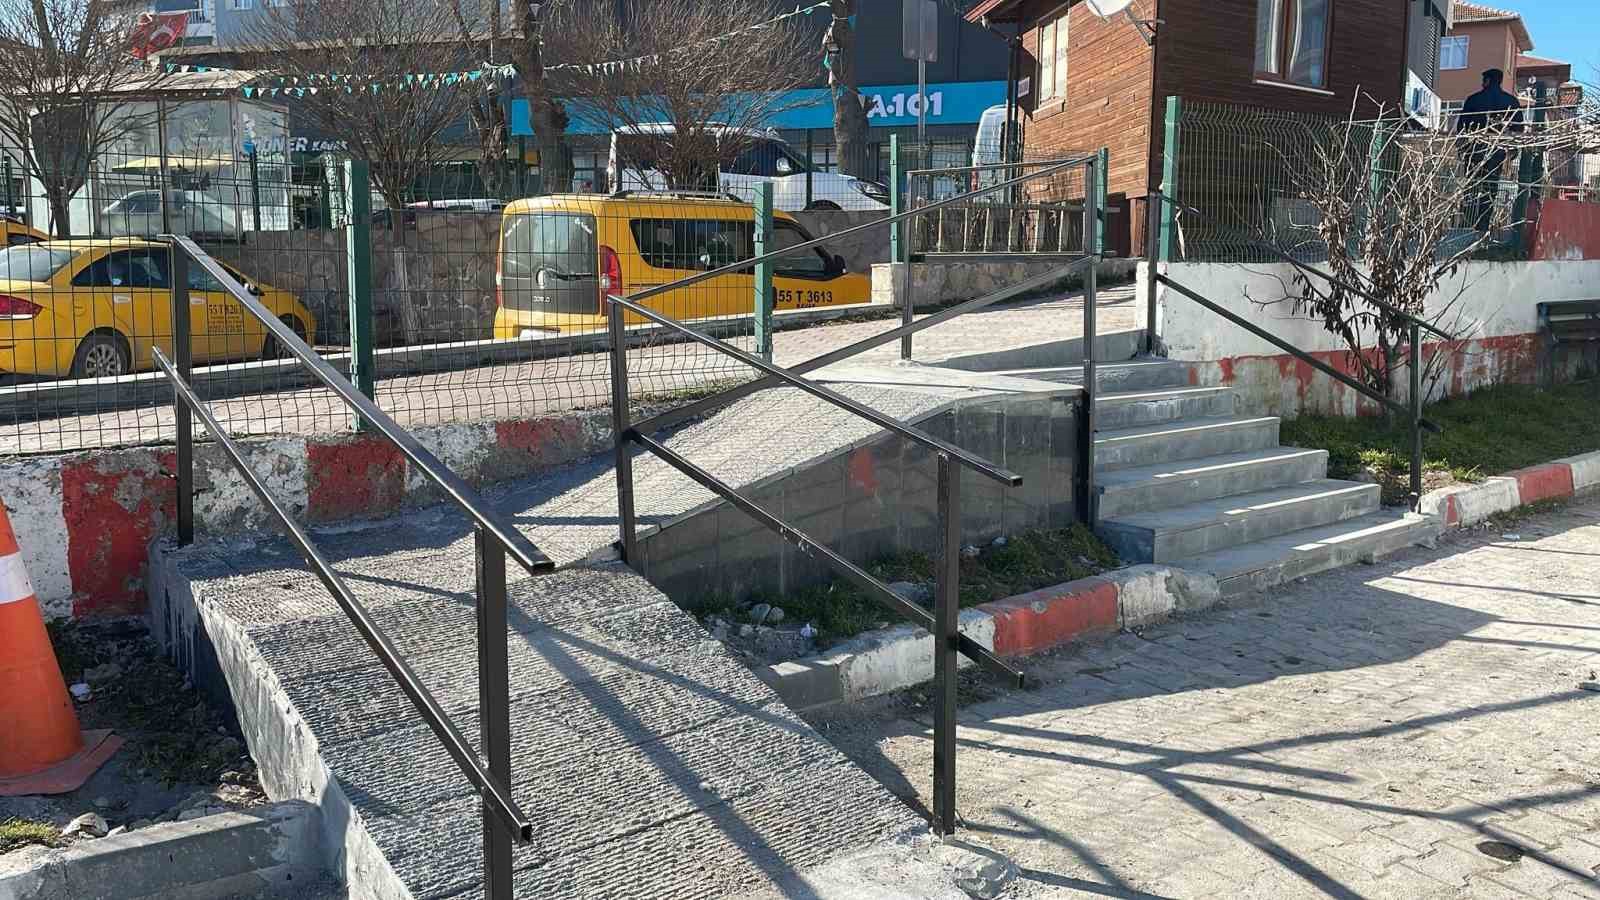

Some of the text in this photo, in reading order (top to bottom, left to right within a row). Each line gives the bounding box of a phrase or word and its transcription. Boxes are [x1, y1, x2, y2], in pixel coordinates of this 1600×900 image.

[779, 290, 833, 303] 55 T 3613
